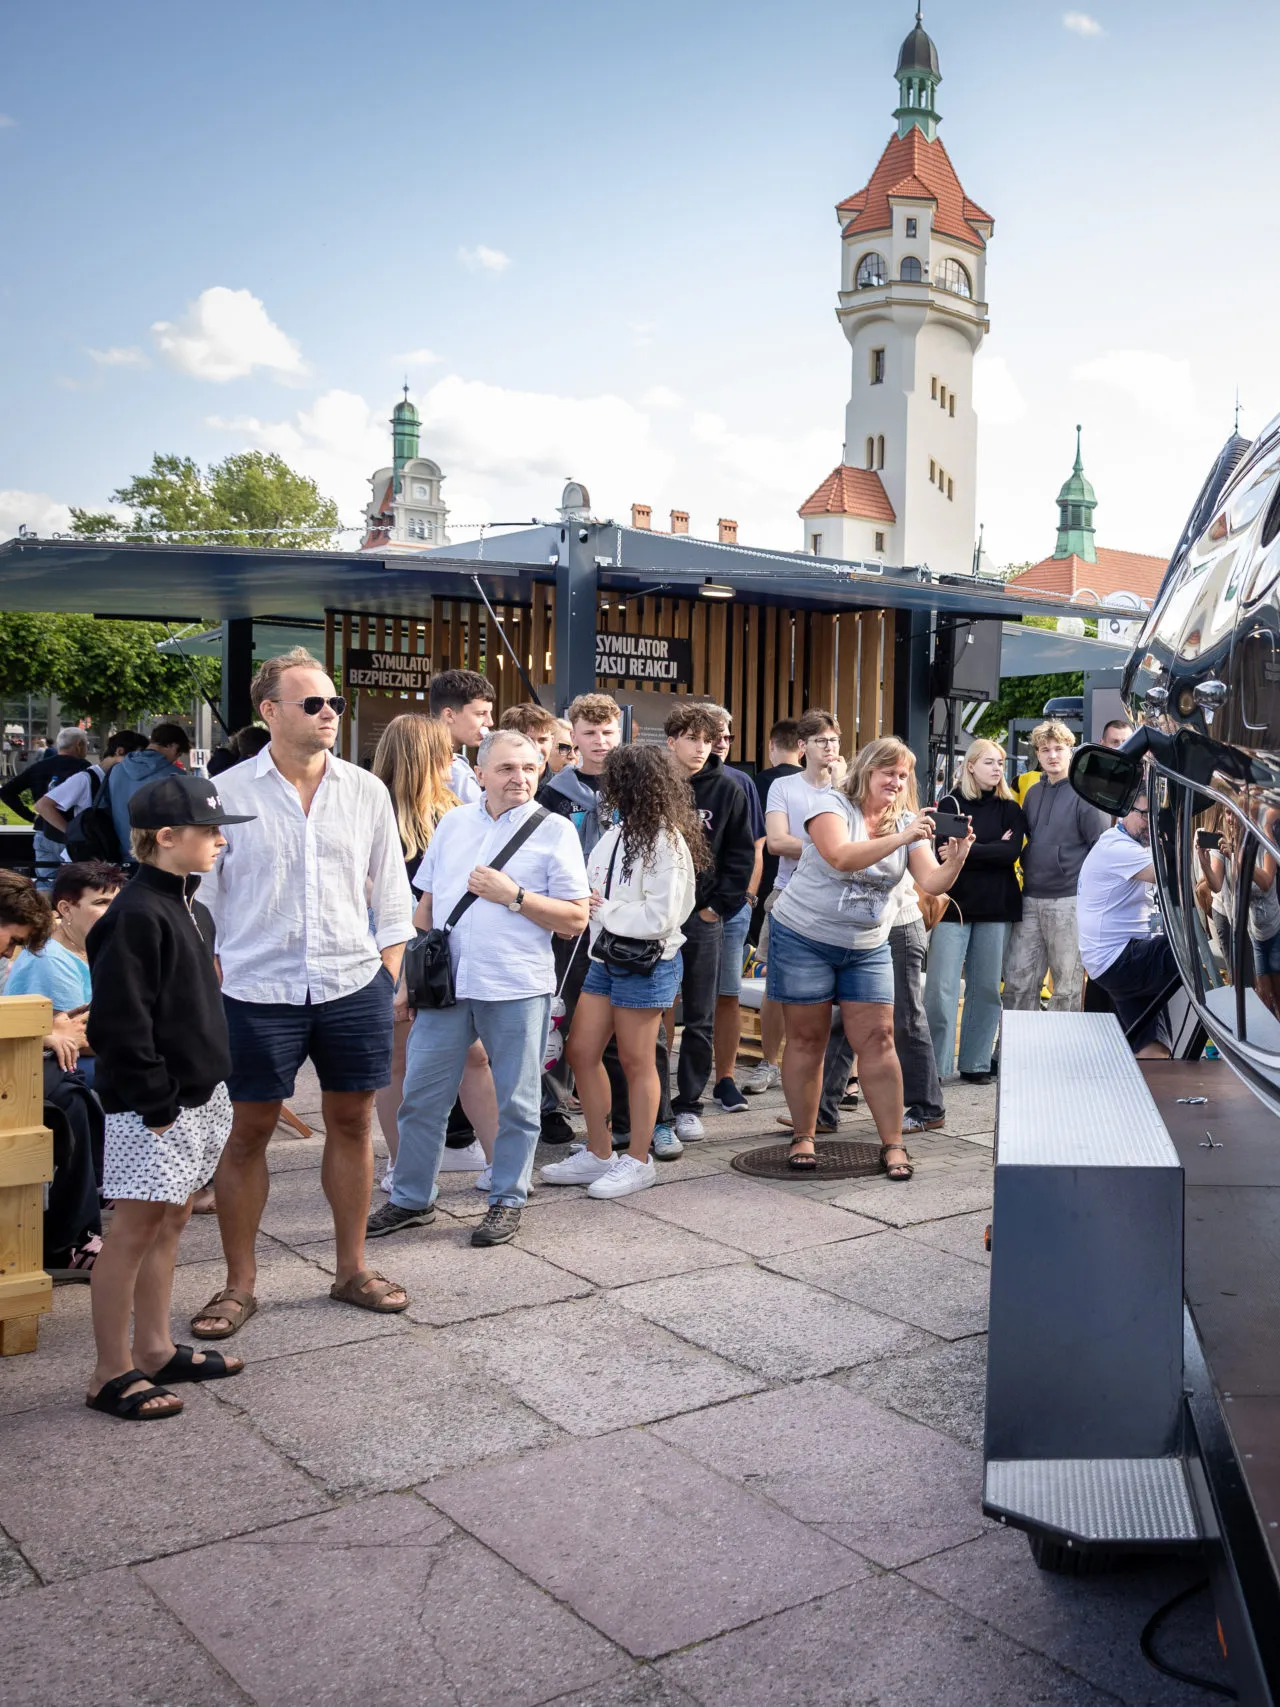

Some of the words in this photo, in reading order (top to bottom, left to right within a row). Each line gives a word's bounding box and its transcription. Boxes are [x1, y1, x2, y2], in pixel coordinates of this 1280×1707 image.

[596, 635, 669, 658] SYMULATOR
[371, 653, 433, 672] SYMULATO
[595, 655, 626, 675] ZASU
[629, 658, 678, 679] REAKCJI
[349, 669, 422, 688] BEZPIECZNEJ
